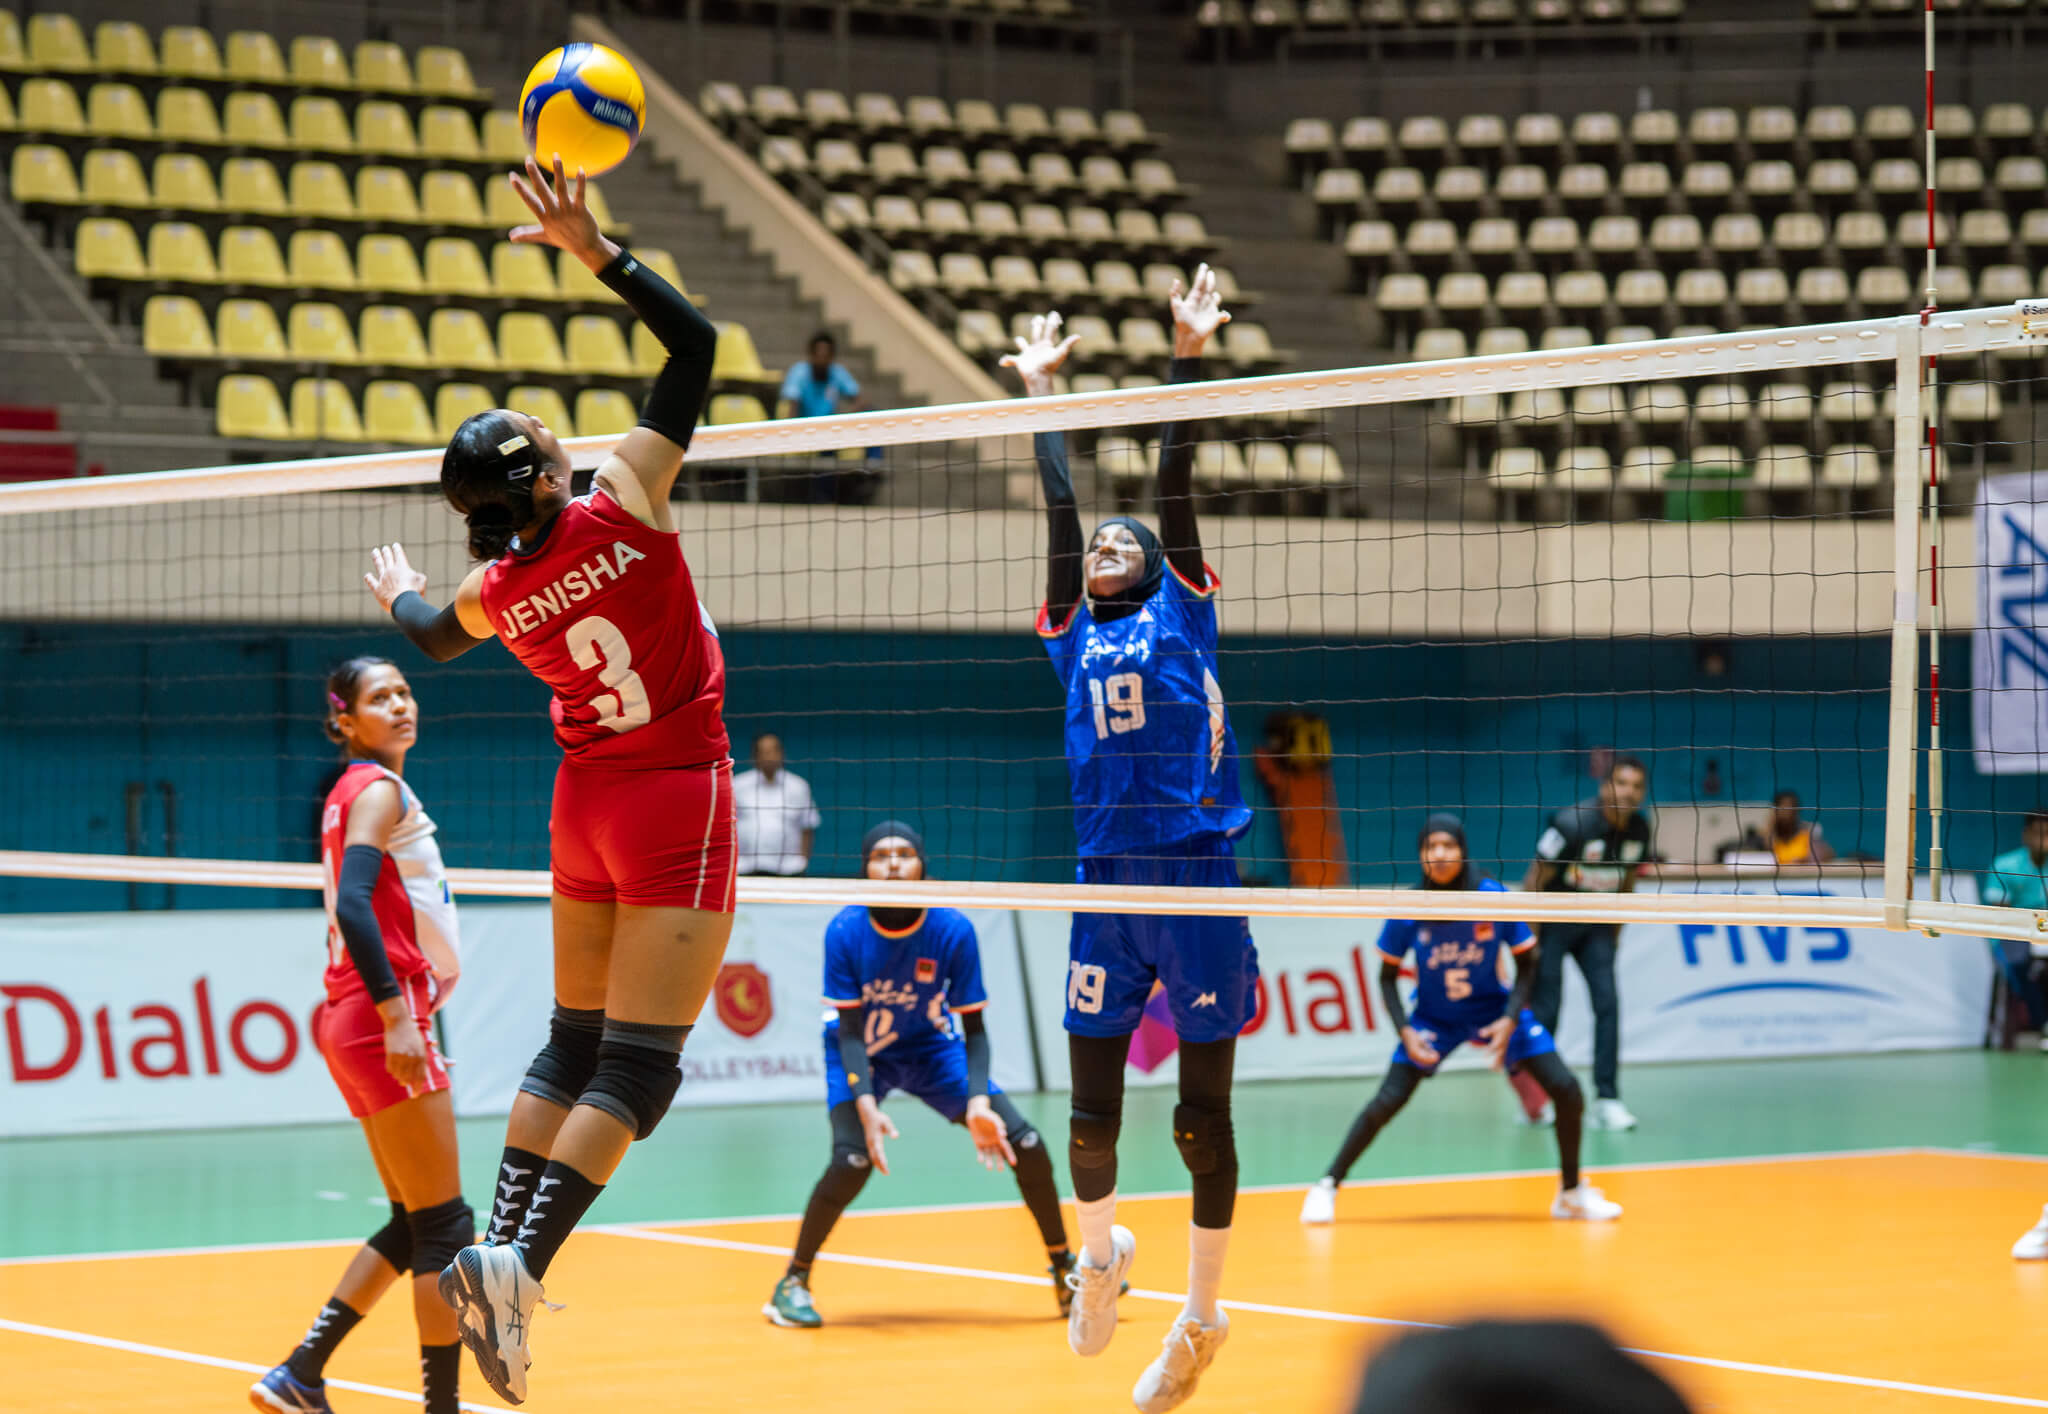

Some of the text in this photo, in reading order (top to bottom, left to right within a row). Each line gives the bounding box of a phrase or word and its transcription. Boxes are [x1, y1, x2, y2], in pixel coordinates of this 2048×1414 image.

[500, 540, 647, 640] JENISHA
[564, 614, 652, 734] 3
[1088, 671, 1147, 741] 19
[1067, 959, 1107, 1015] 19
[1444, 967, 1473, 1002] 5
[682, 1053, 819, 1081] OLLEYBALL
